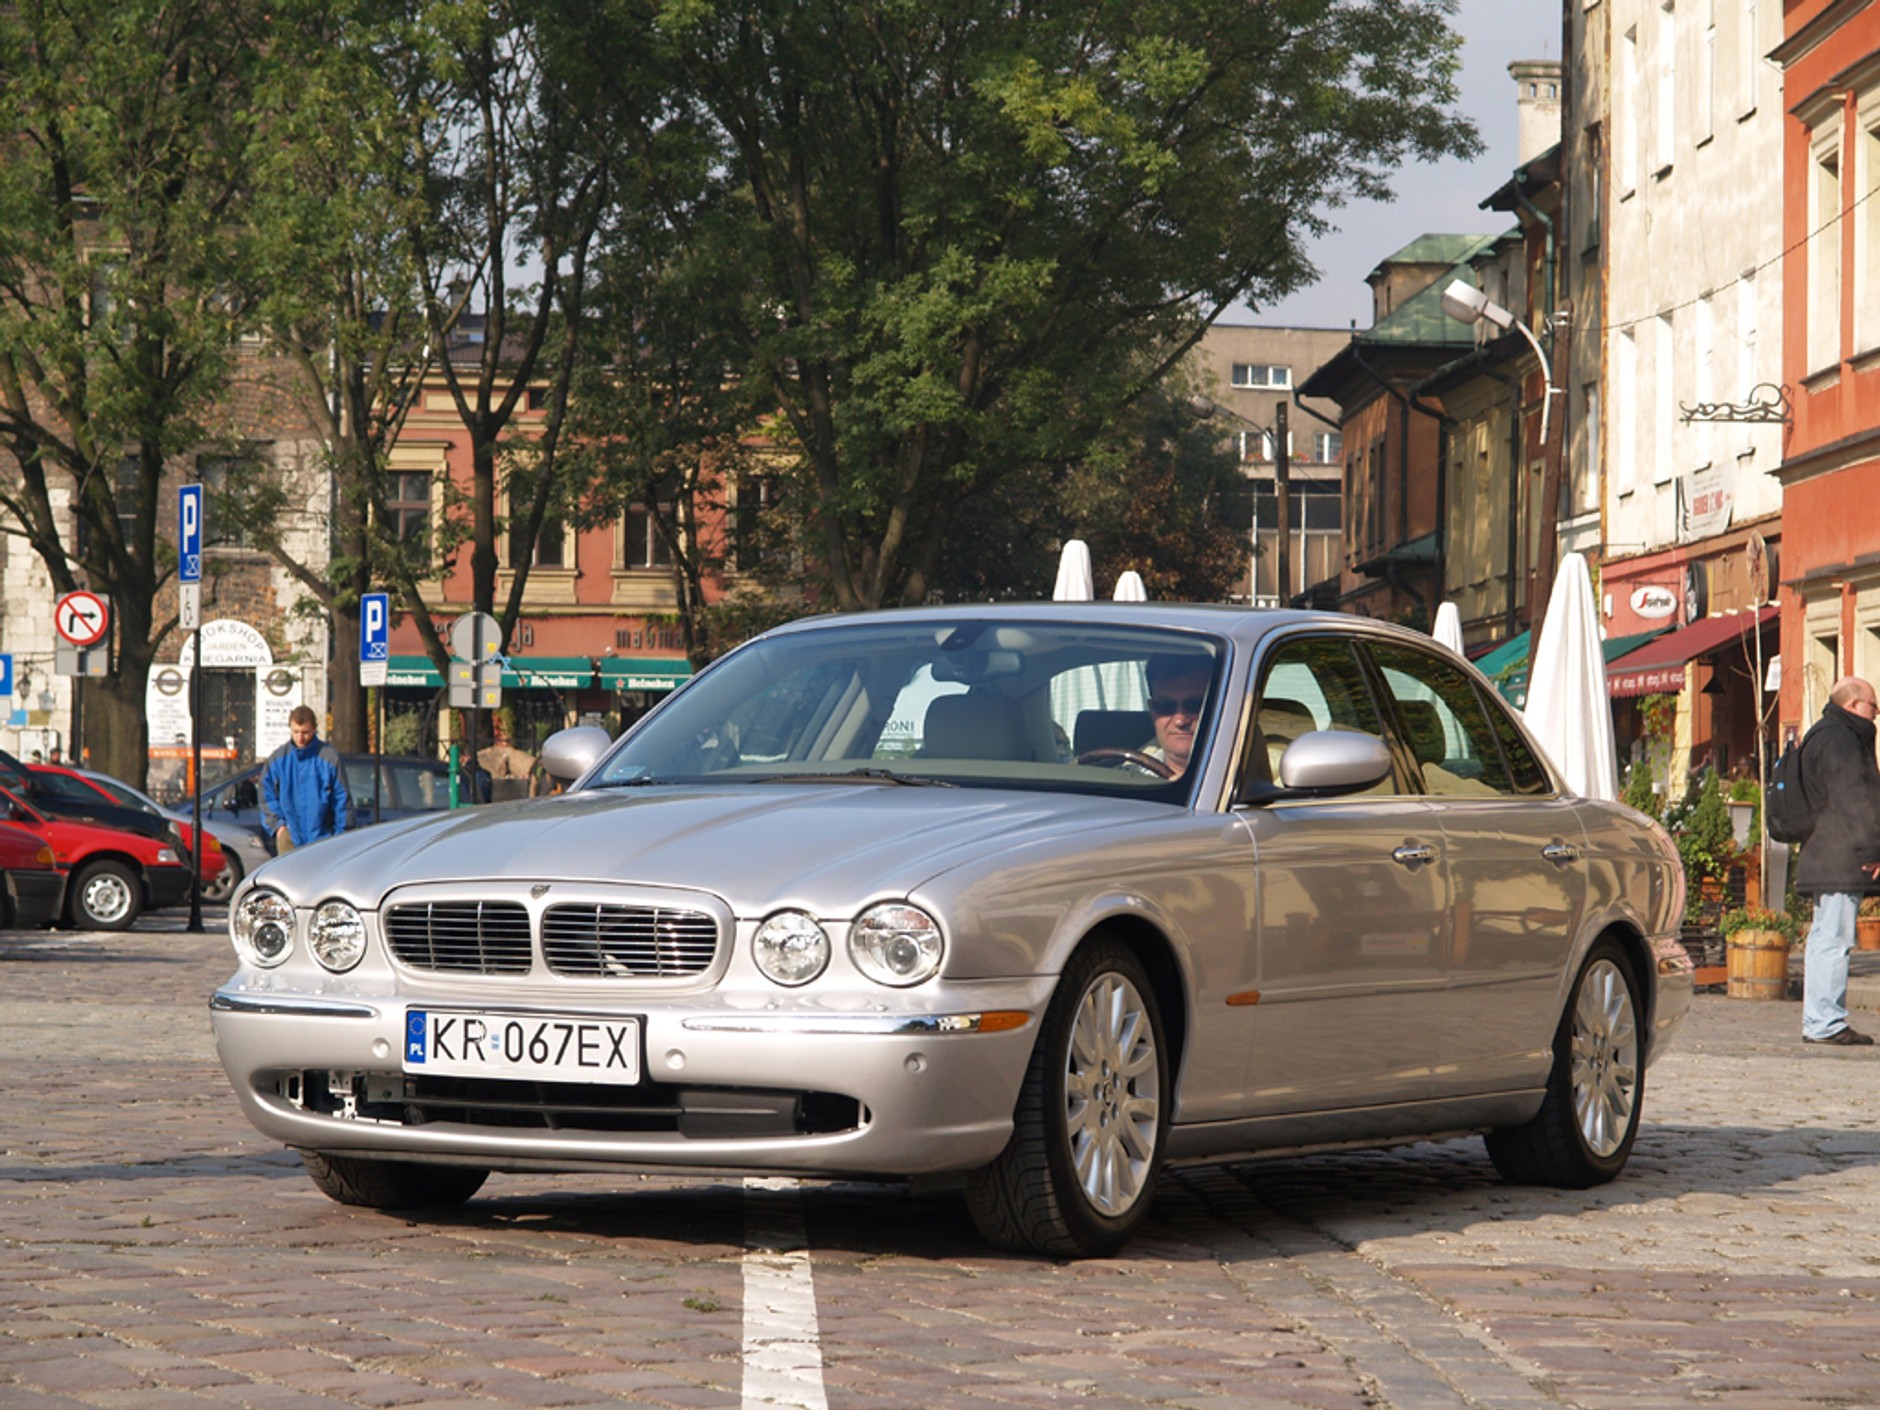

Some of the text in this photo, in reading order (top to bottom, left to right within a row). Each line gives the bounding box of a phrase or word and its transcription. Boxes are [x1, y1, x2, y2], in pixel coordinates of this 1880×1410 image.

[183, 494, 197, 553] P
[366, 600, 383, 643] P
[409, 1042, 424, 1056] PL
[433, 1017, 628, 1069] KR 067EX
